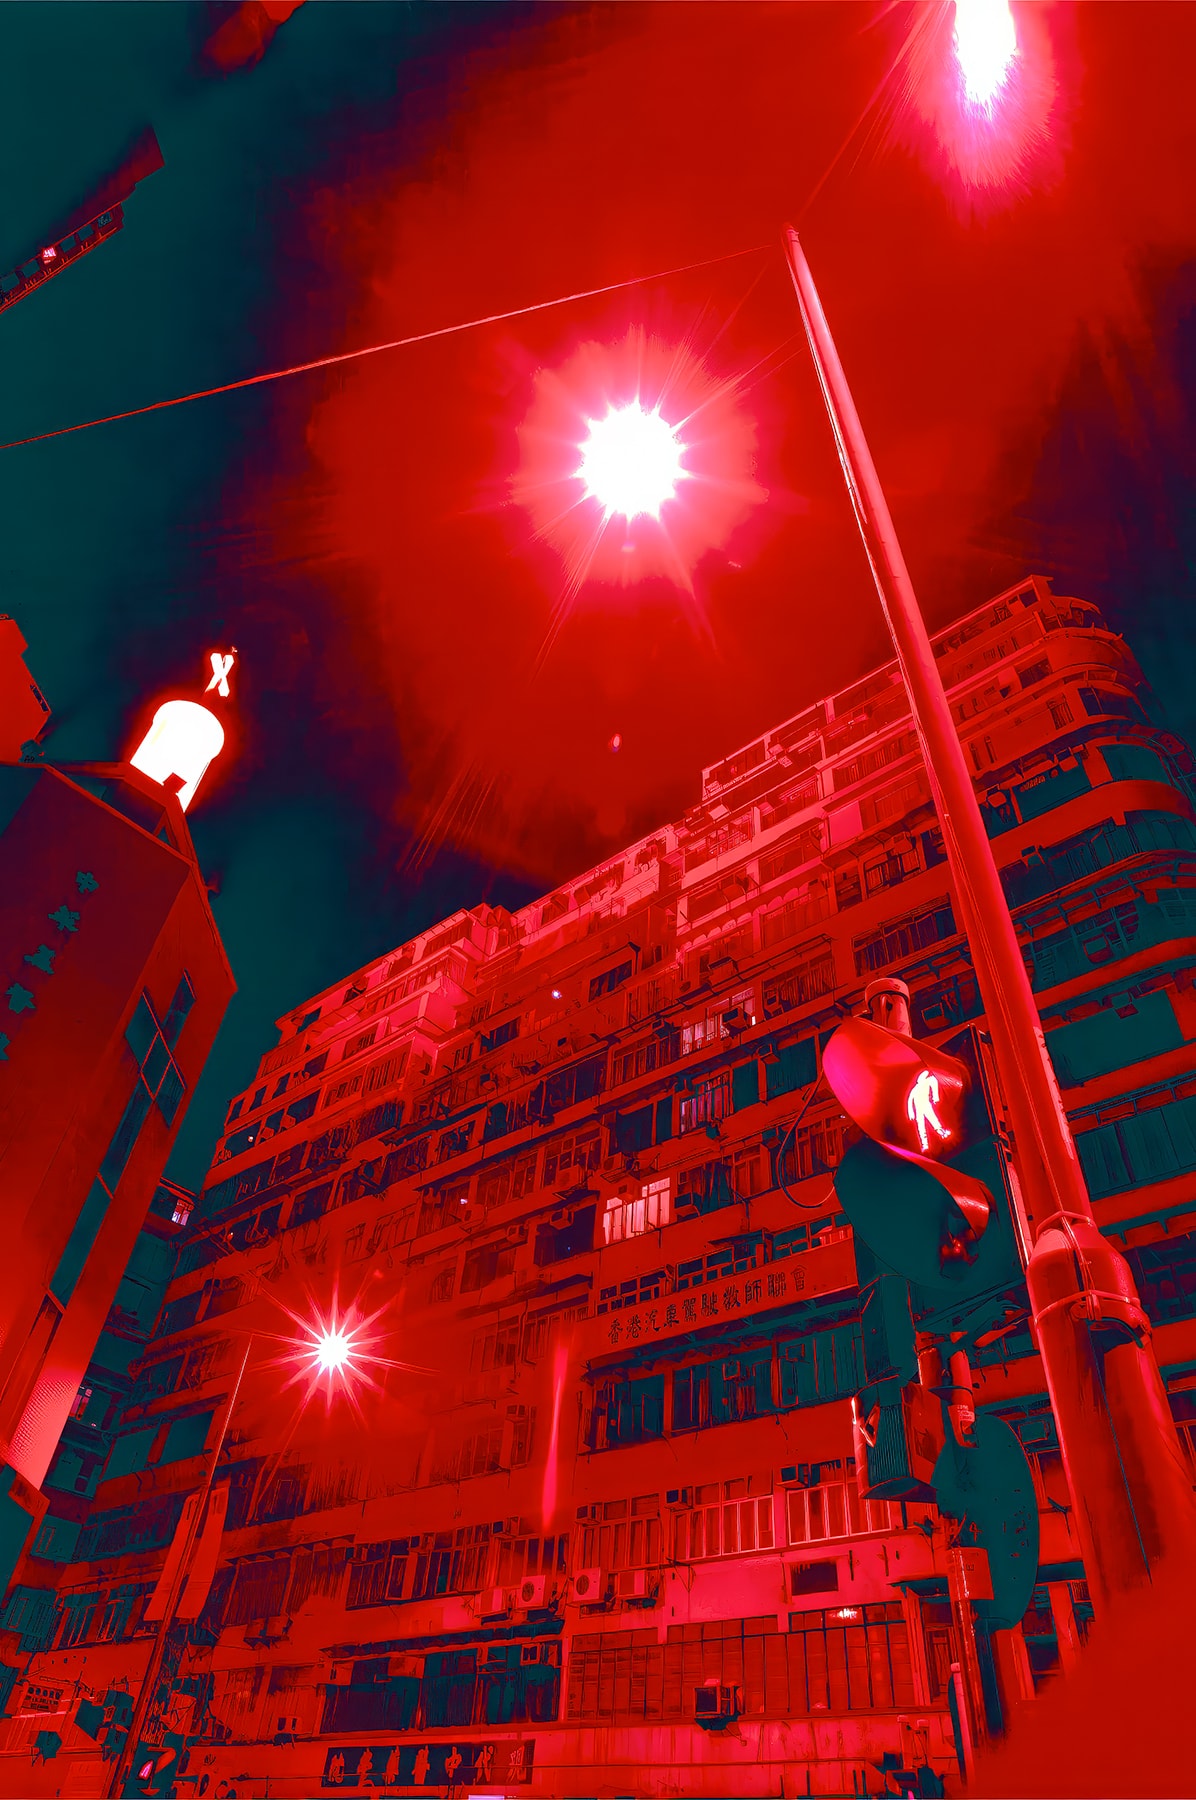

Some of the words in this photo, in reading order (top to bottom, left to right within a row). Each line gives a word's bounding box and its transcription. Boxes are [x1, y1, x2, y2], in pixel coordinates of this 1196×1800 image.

[607, 1264, 808, 1345] 香港汽車駕駛教師聯會
